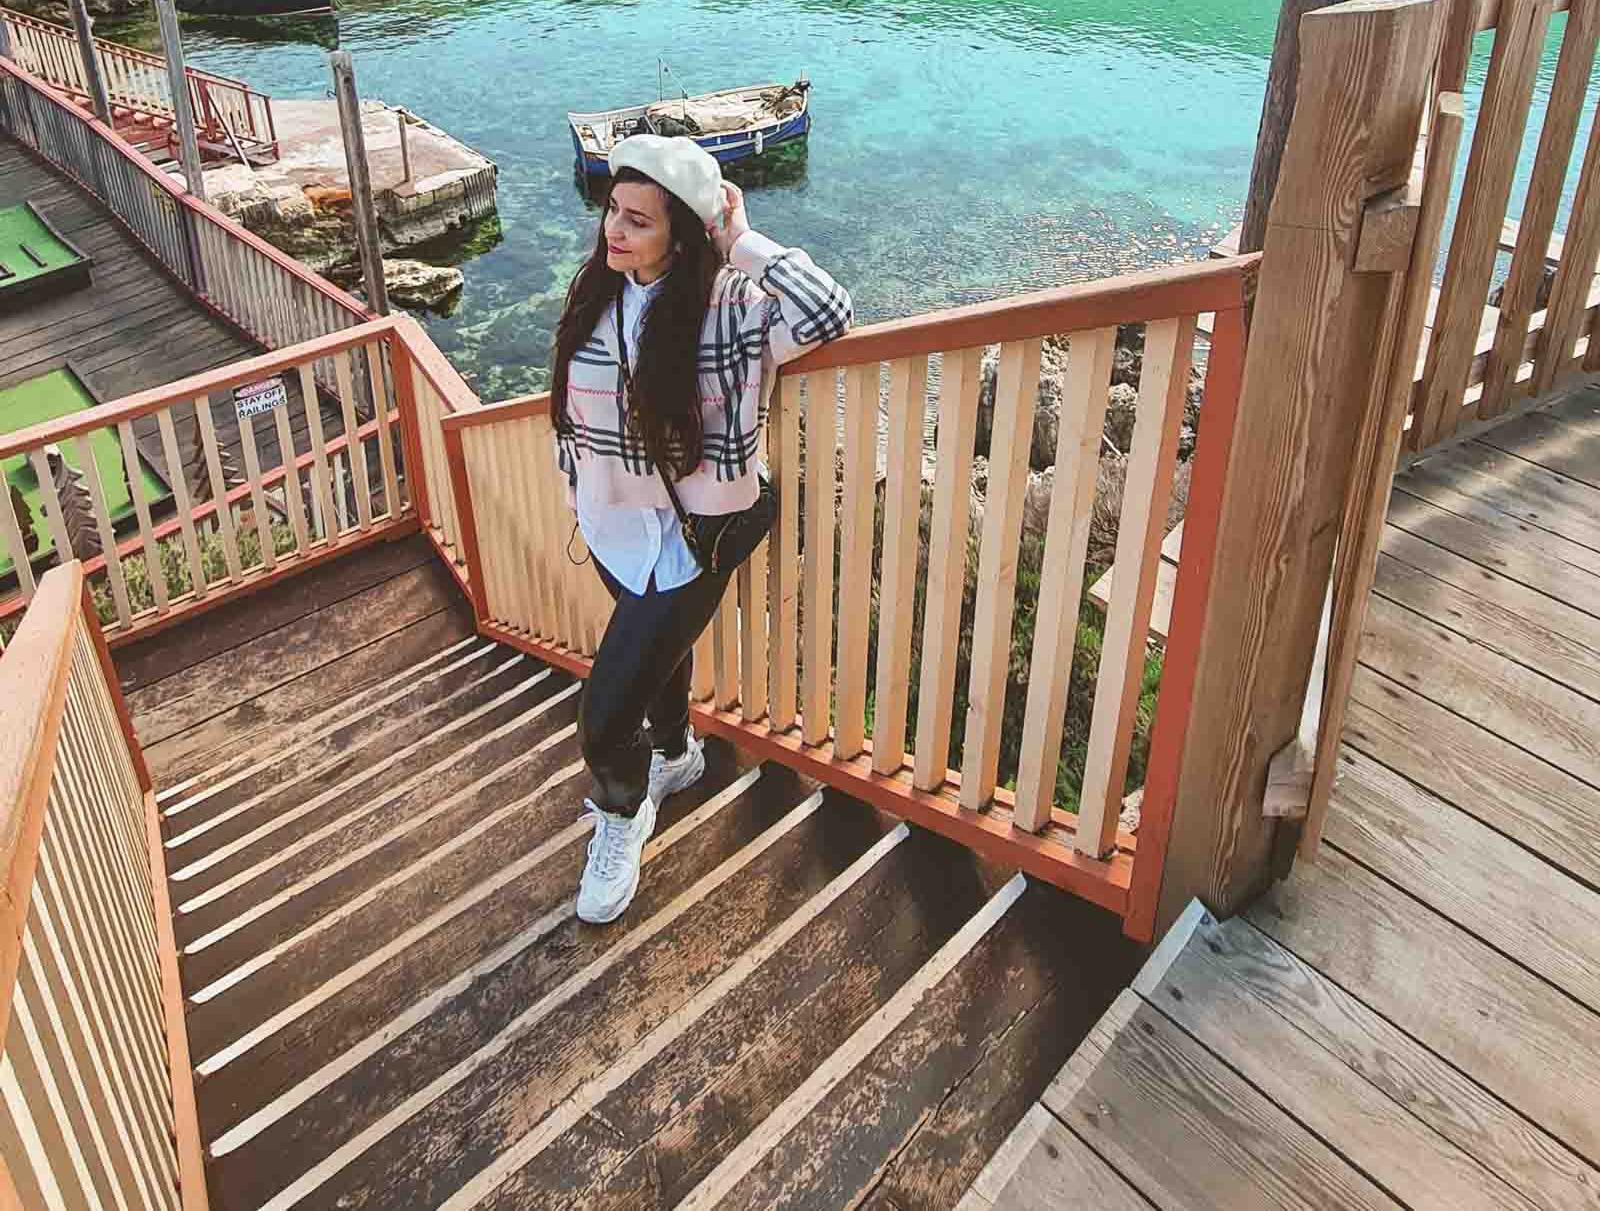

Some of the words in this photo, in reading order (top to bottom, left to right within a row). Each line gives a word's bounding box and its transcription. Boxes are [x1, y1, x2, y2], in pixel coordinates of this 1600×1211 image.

[237, 394, 261, 408] STAY
[264, 388, 282, 399] OFF
[239, 394, 285, 418] RAILINGS
